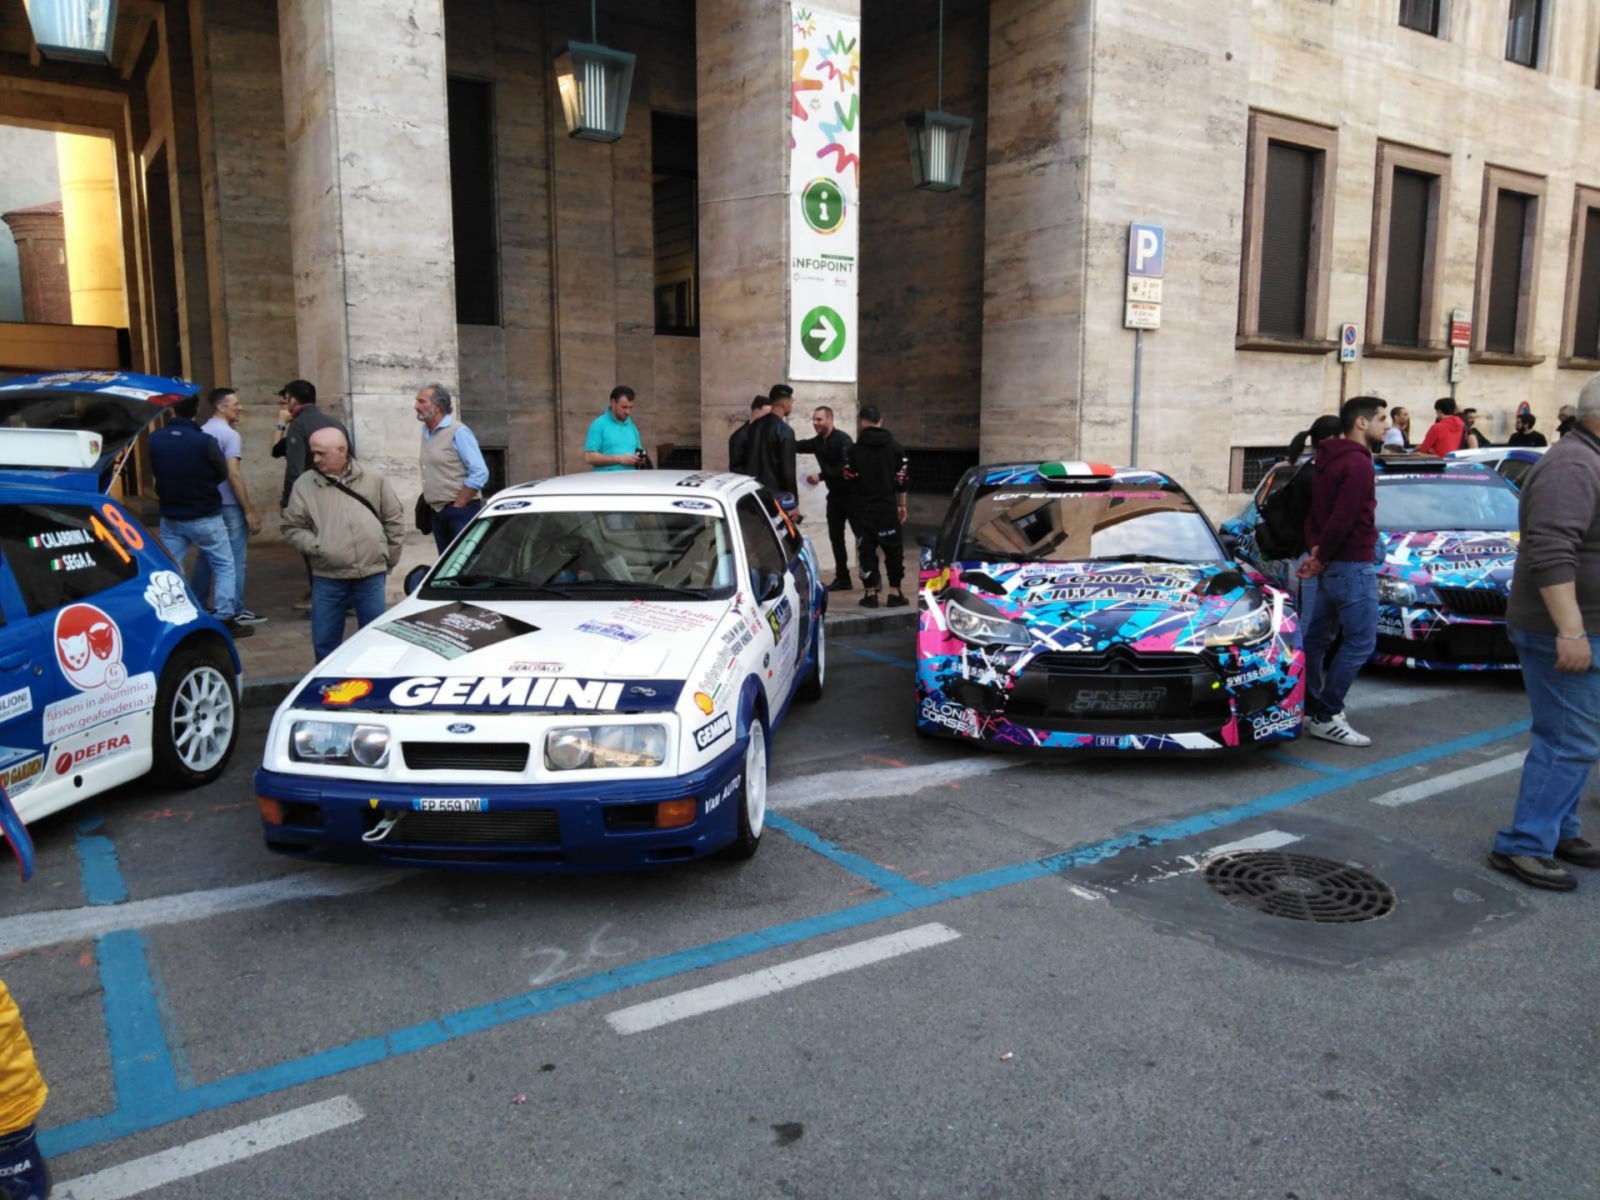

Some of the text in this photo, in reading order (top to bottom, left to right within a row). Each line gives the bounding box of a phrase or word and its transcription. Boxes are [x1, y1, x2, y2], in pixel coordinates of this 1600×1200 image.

[1136, 229, 1158, 270] P
[90, 503, 144, 563] 18
[47, 682, 149, 722] fusioni in alluminio
[389, 677, 625, 711] GEMINI
[47, 694, 155, 738] www.geafonderia.it
[1253, 703, 1301, 729] OLONIA
[74, 734, 131, 762] DEFRA
